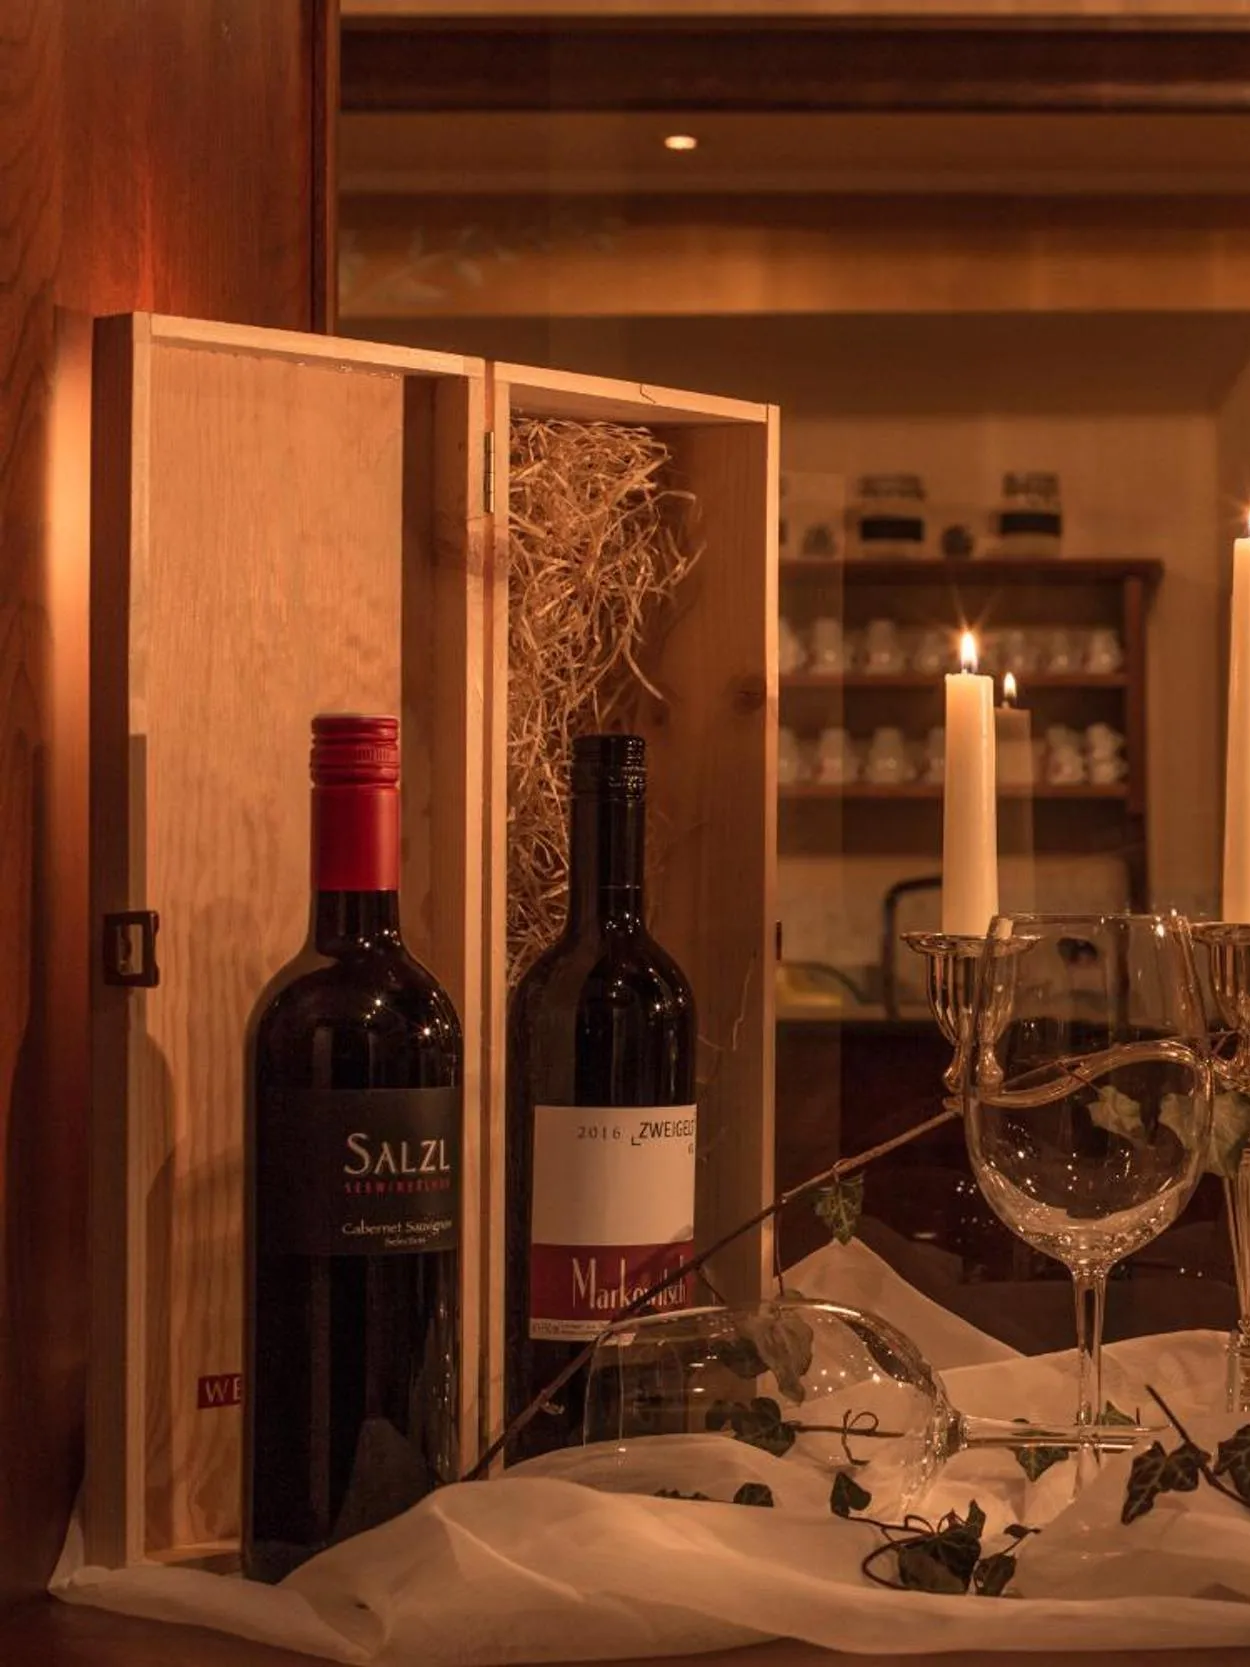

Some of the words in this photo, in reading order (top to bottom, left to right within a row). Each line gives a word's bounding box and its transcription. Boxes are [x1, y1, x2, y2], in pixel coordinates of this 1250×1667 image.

[577, 1126, 622, 1139] 2016
[343, 1132, 451, 1175] SALZL
[342, 1218, 402, 1234] Cabernet
